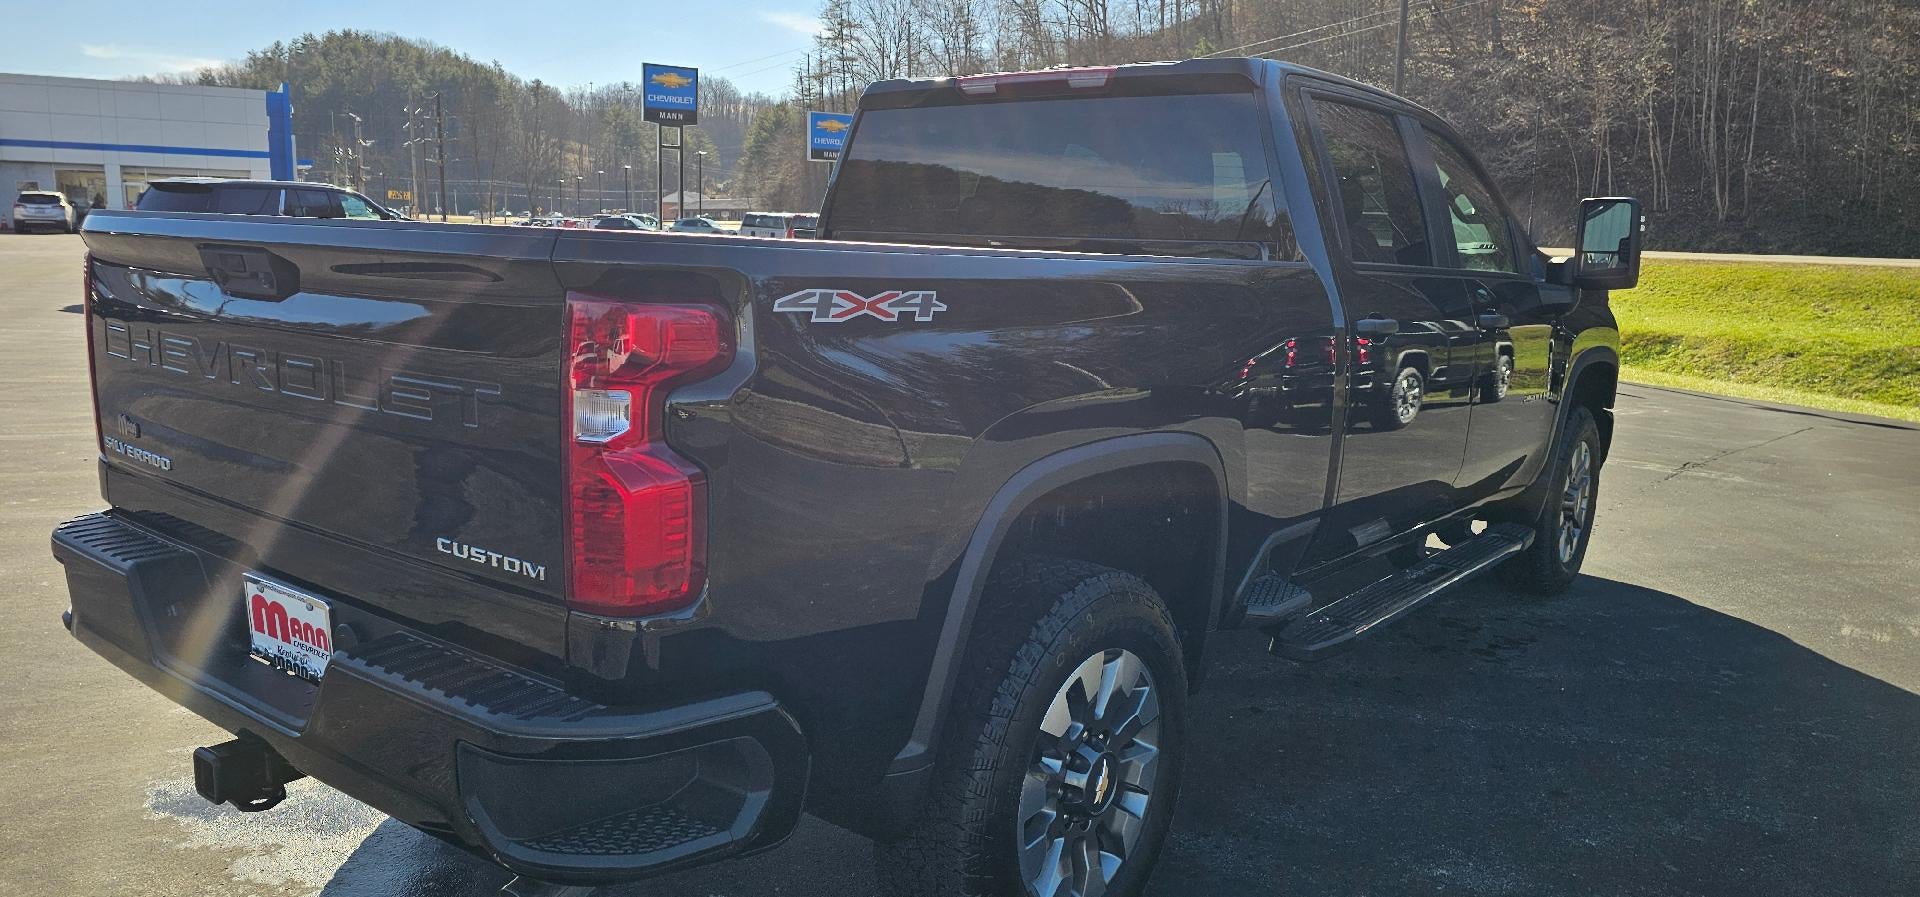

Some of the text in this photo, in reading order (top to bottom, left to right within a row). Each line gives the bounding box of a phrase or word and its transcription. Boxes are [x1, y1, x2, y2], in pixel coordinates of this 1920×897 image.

[647, 94, 694, 105] CHEVROLET
[659, 111, 684, 121] MANN
[814, 137, 842, 146] CHEVROL
[104, 320, 501, 428] CHEVROLET
[104, 435, 173, 472] SILVERADO
[436, 536, 547, 582] CUSTOM
[293, 640, 330, 661] CHEVROLET
